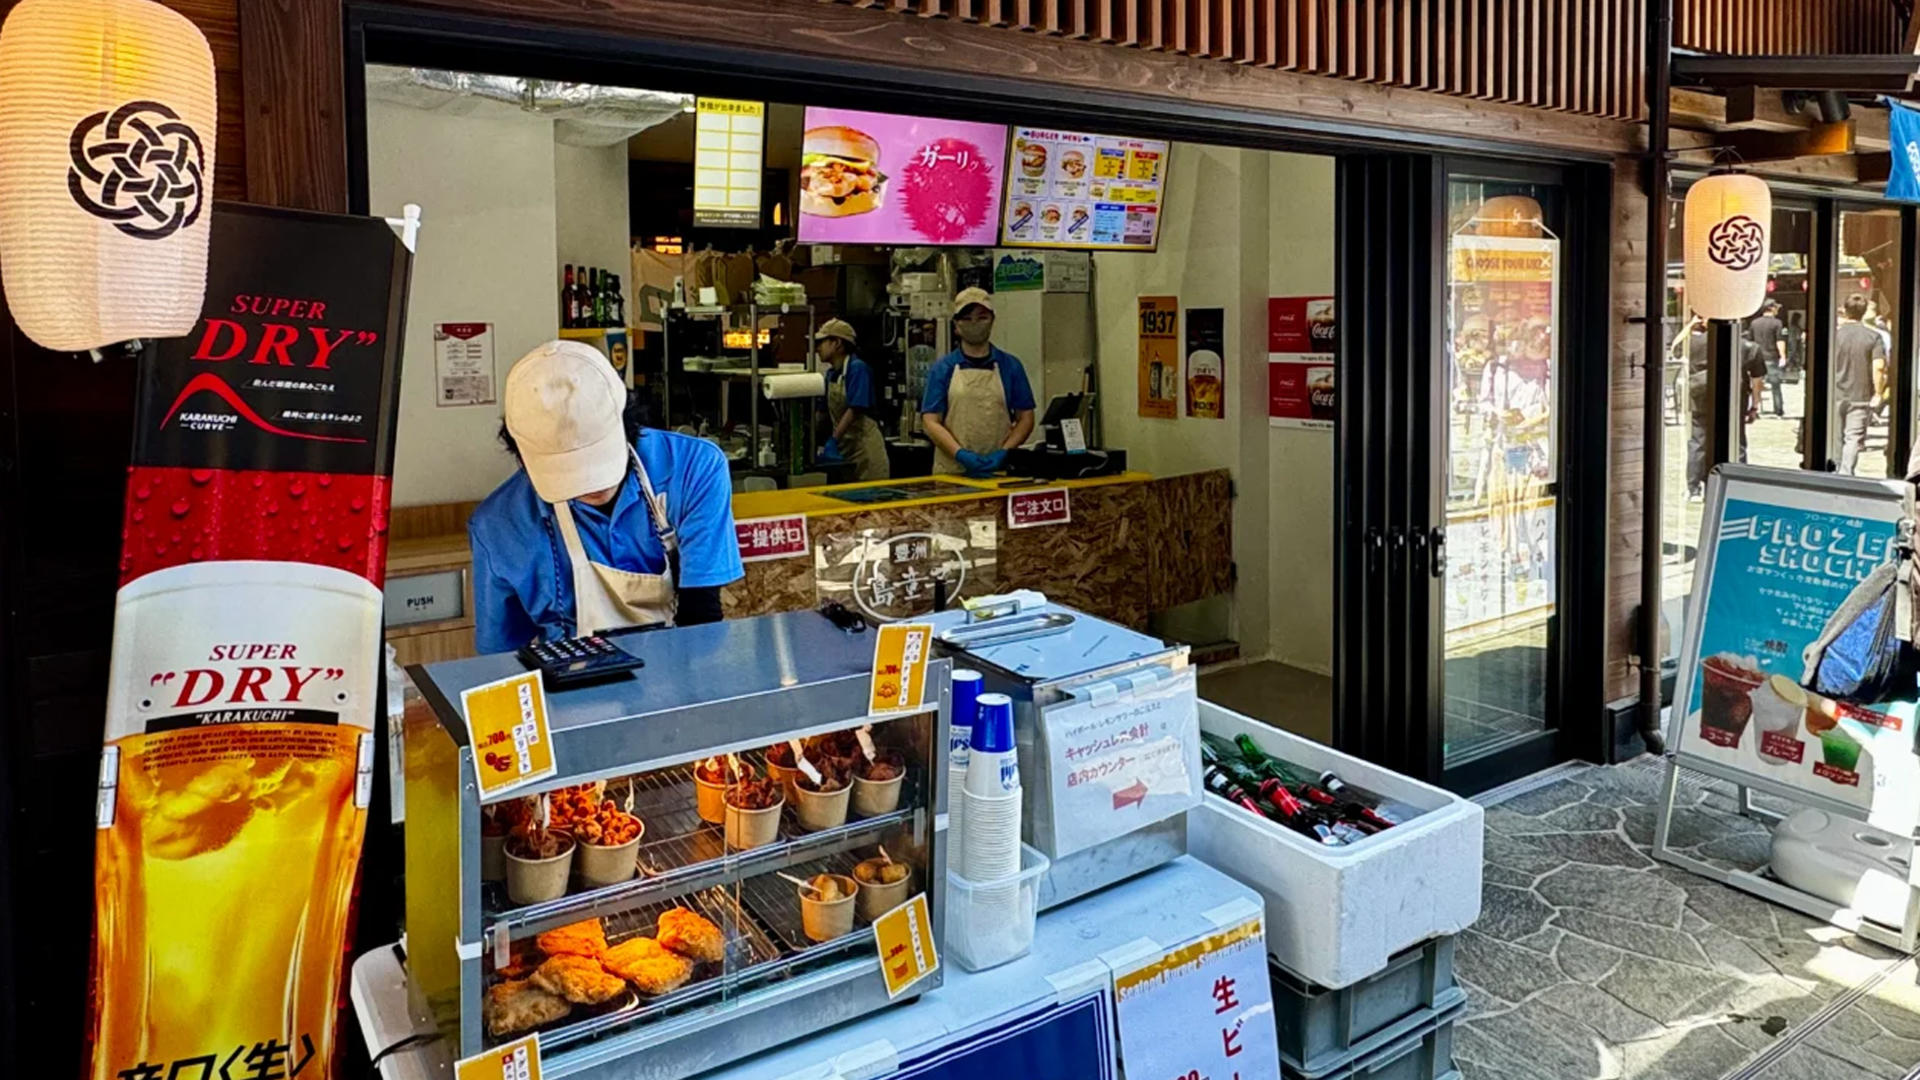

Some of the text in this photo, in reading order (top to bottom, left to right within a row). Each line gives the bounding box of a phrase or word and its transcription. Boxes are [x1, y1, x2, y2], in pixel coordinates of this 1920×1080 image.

[1030, 130, 1082, 142] BURGER MENU
[231, 294, 327, 320] SUPER
[1140, 310, 1176, 333] 1937
[180, 412, 238, 423] KARAKUCHI
[190, 423, 224, 431] CURVE
[1014, 498, 1064, 516] ご注文口
[738, 527, 800, 549] ご提供口
[407, 596, 434, 607] PUSH
[208, 644, 297, 661] SUPER
[1067, 756, 1136, 787] 店内カウンター
[1212, 974, 1244, 1080] 生ビ
